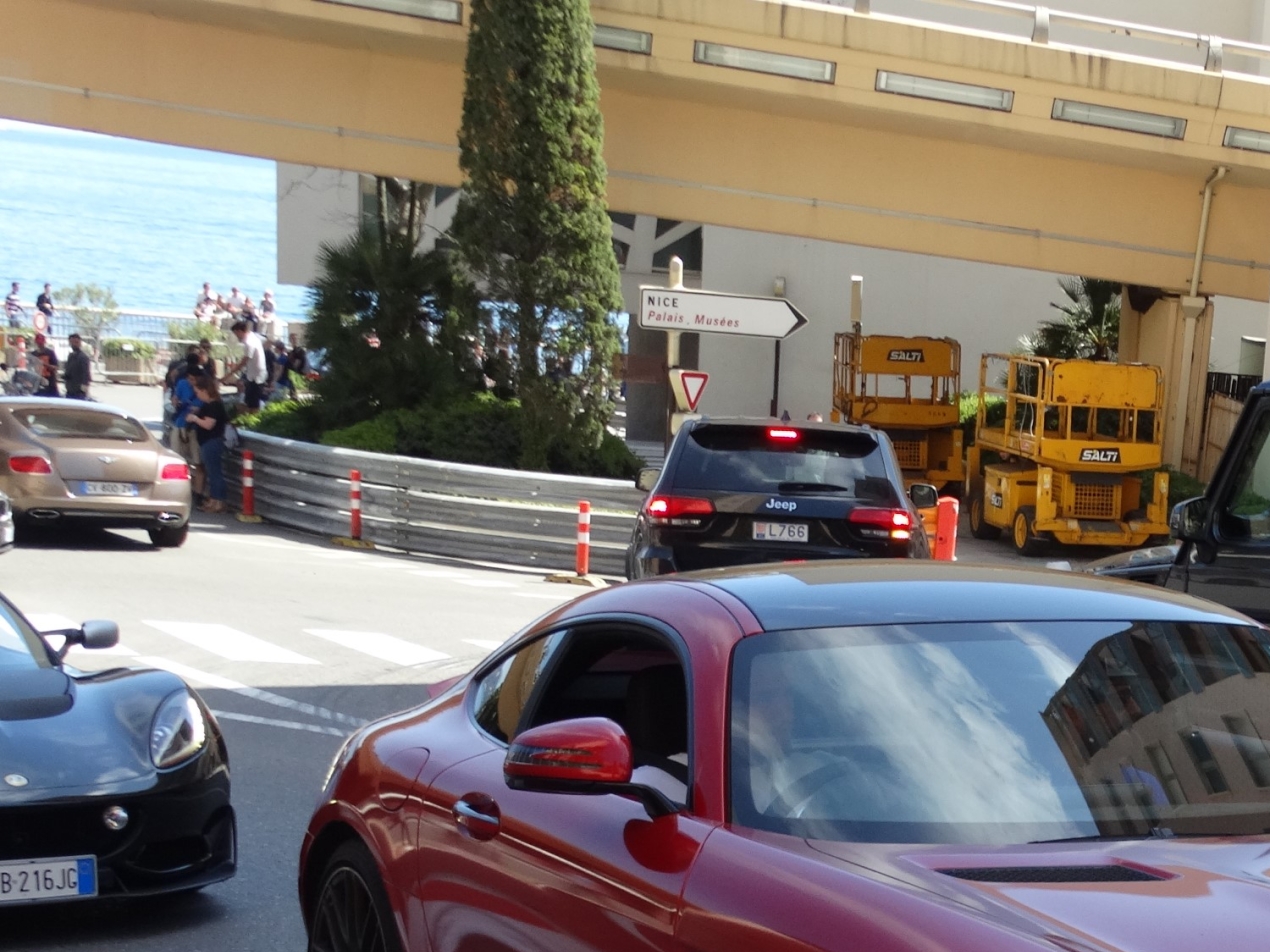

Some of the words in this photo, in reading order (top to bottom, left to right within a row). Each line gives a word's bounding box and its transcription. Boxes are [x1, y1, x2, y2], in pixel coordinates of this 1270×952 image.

[647, 295, 679, 308] NICE
[694, 314, 740, 328] Musées
[889, 350, 922, 362] SALTI
[1081, 449, 1119, 462] SALTI
[765, 498, 797, 512] Jeep
[769, 524, 805, 538] L766
